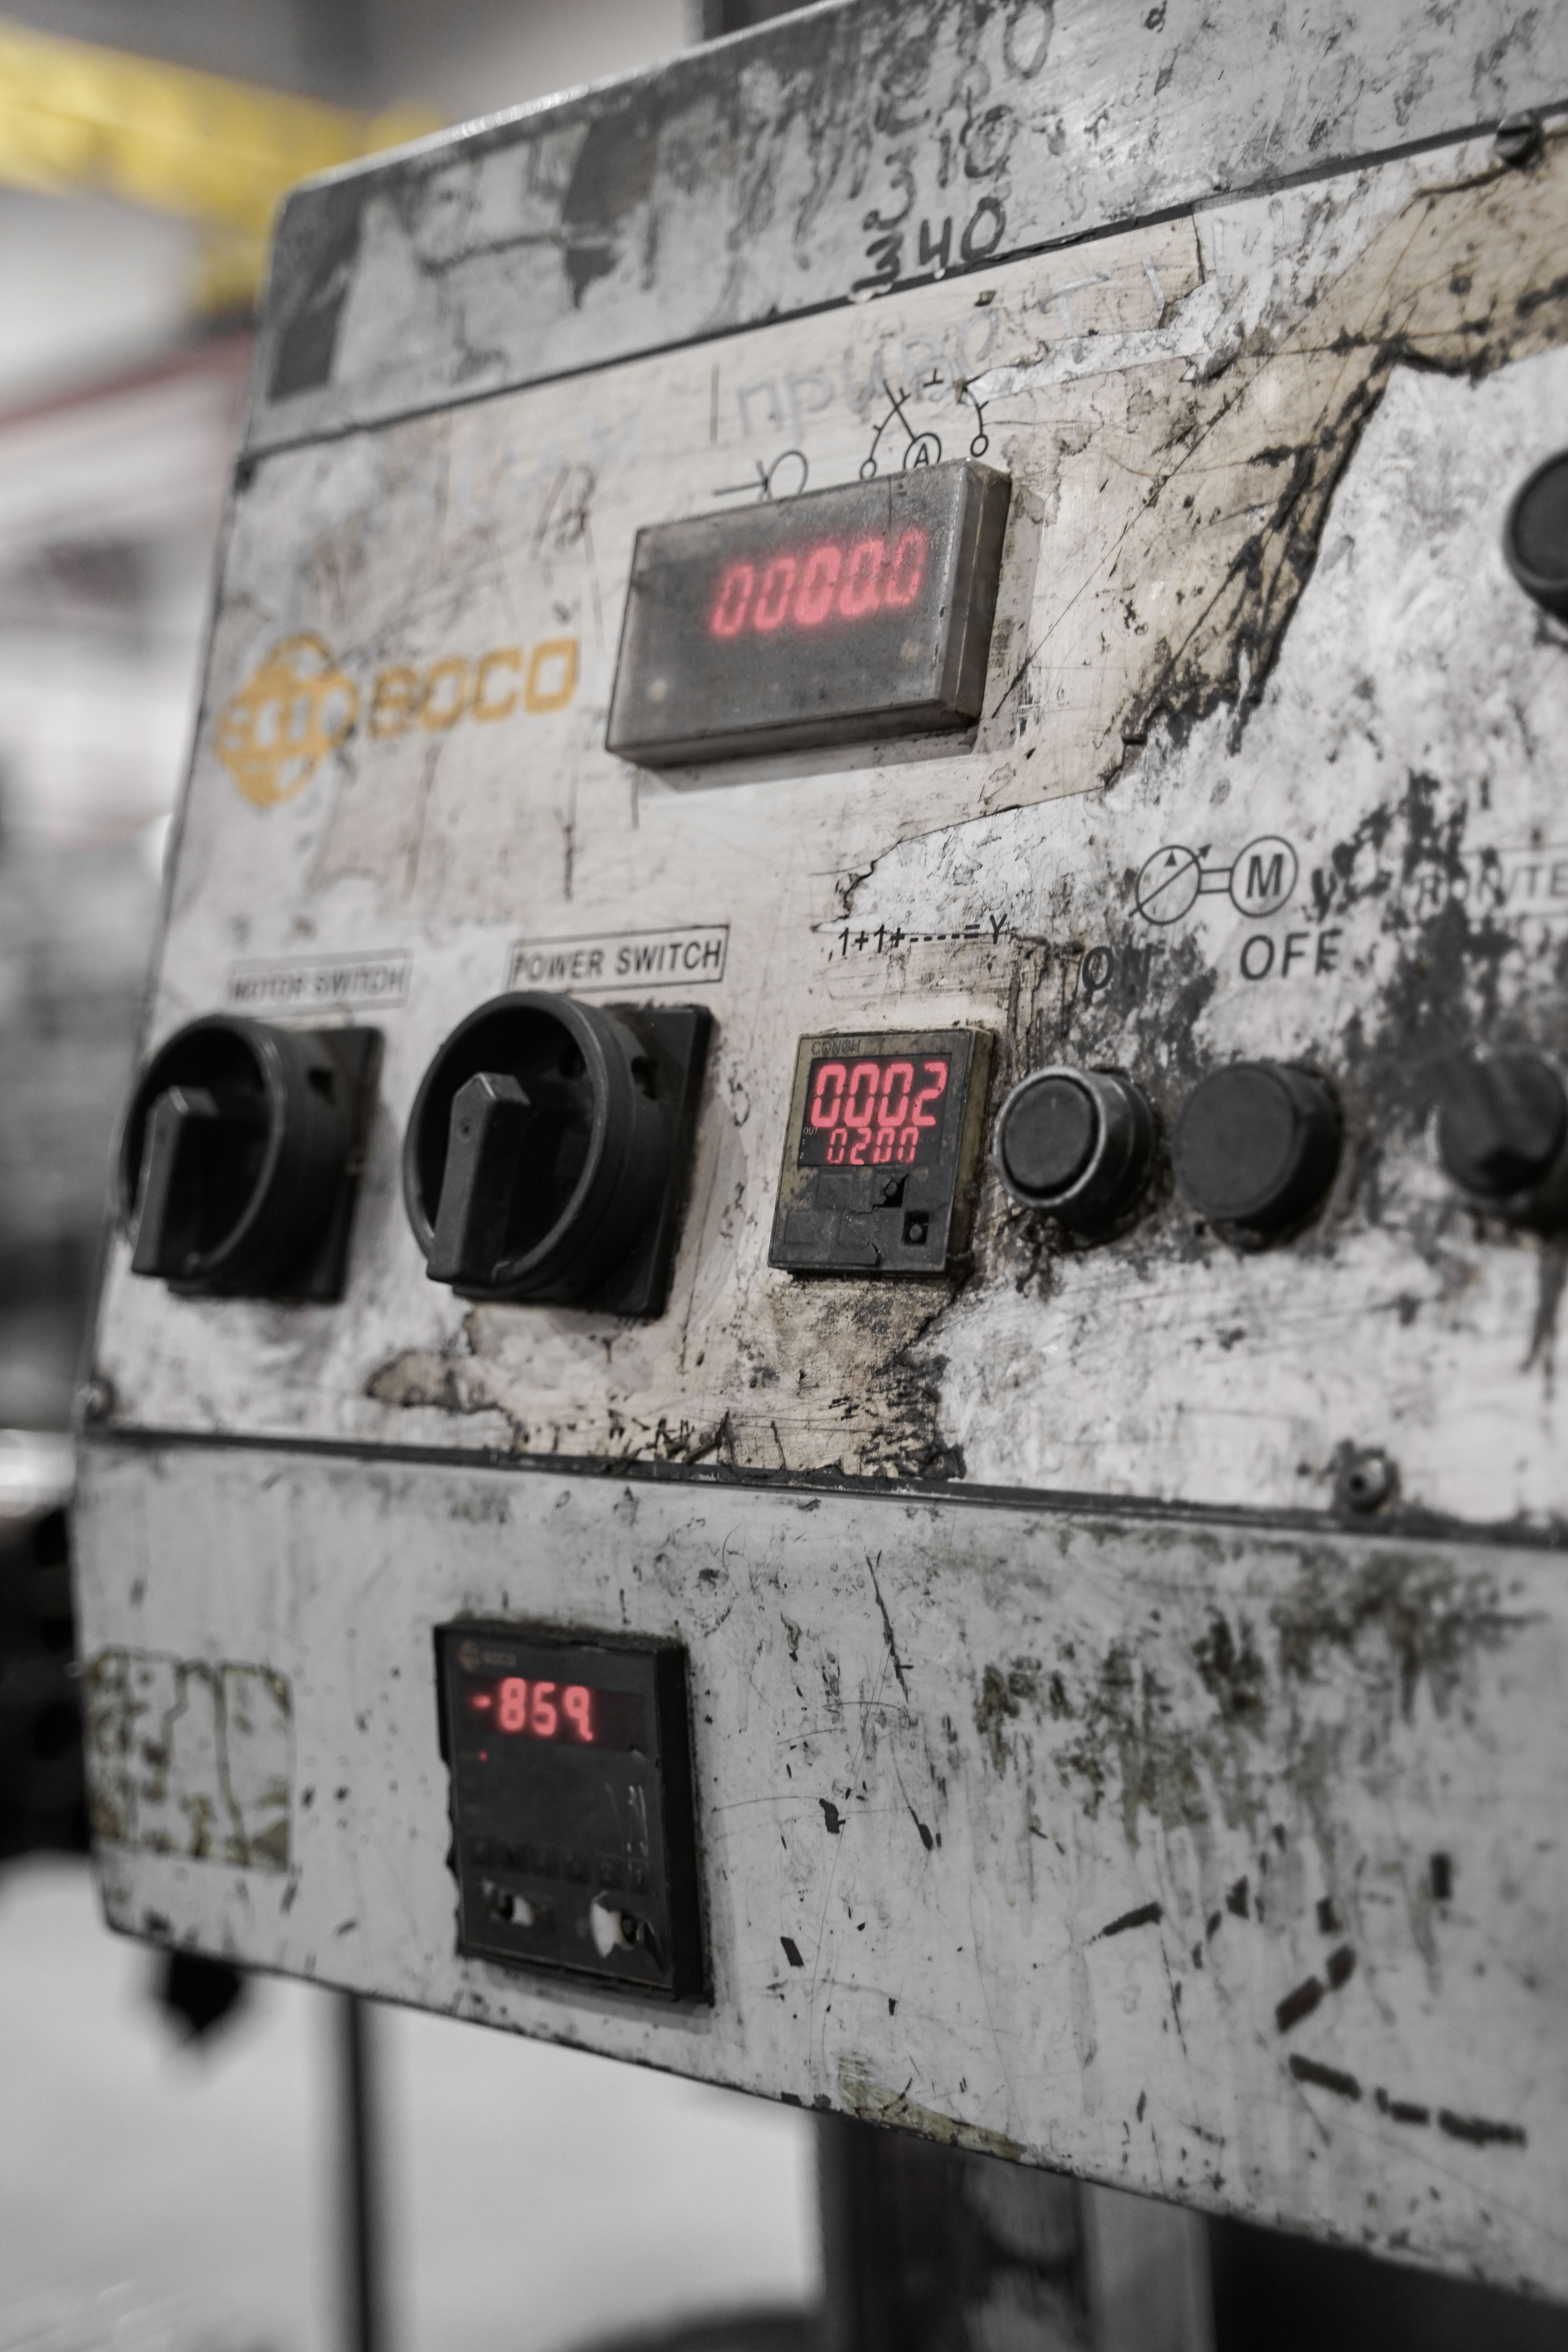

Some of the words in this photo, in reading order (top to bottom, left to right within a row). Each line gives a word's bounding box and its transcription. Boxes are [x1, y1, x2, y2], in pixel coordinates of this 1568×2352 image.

[851, 196, 1007, 293] 340
[1246, 852, 1285, 898] M
[315, 964, 406, 998] SWITCH
[514, 946, 606, 982] POWER
[613, 938, 722, 976] SWITCH
[811, 1062, 948, 1127] 0002
[802, 1126, 819, 1136] OUT
[827, 1127, 919, 1165] 0200
